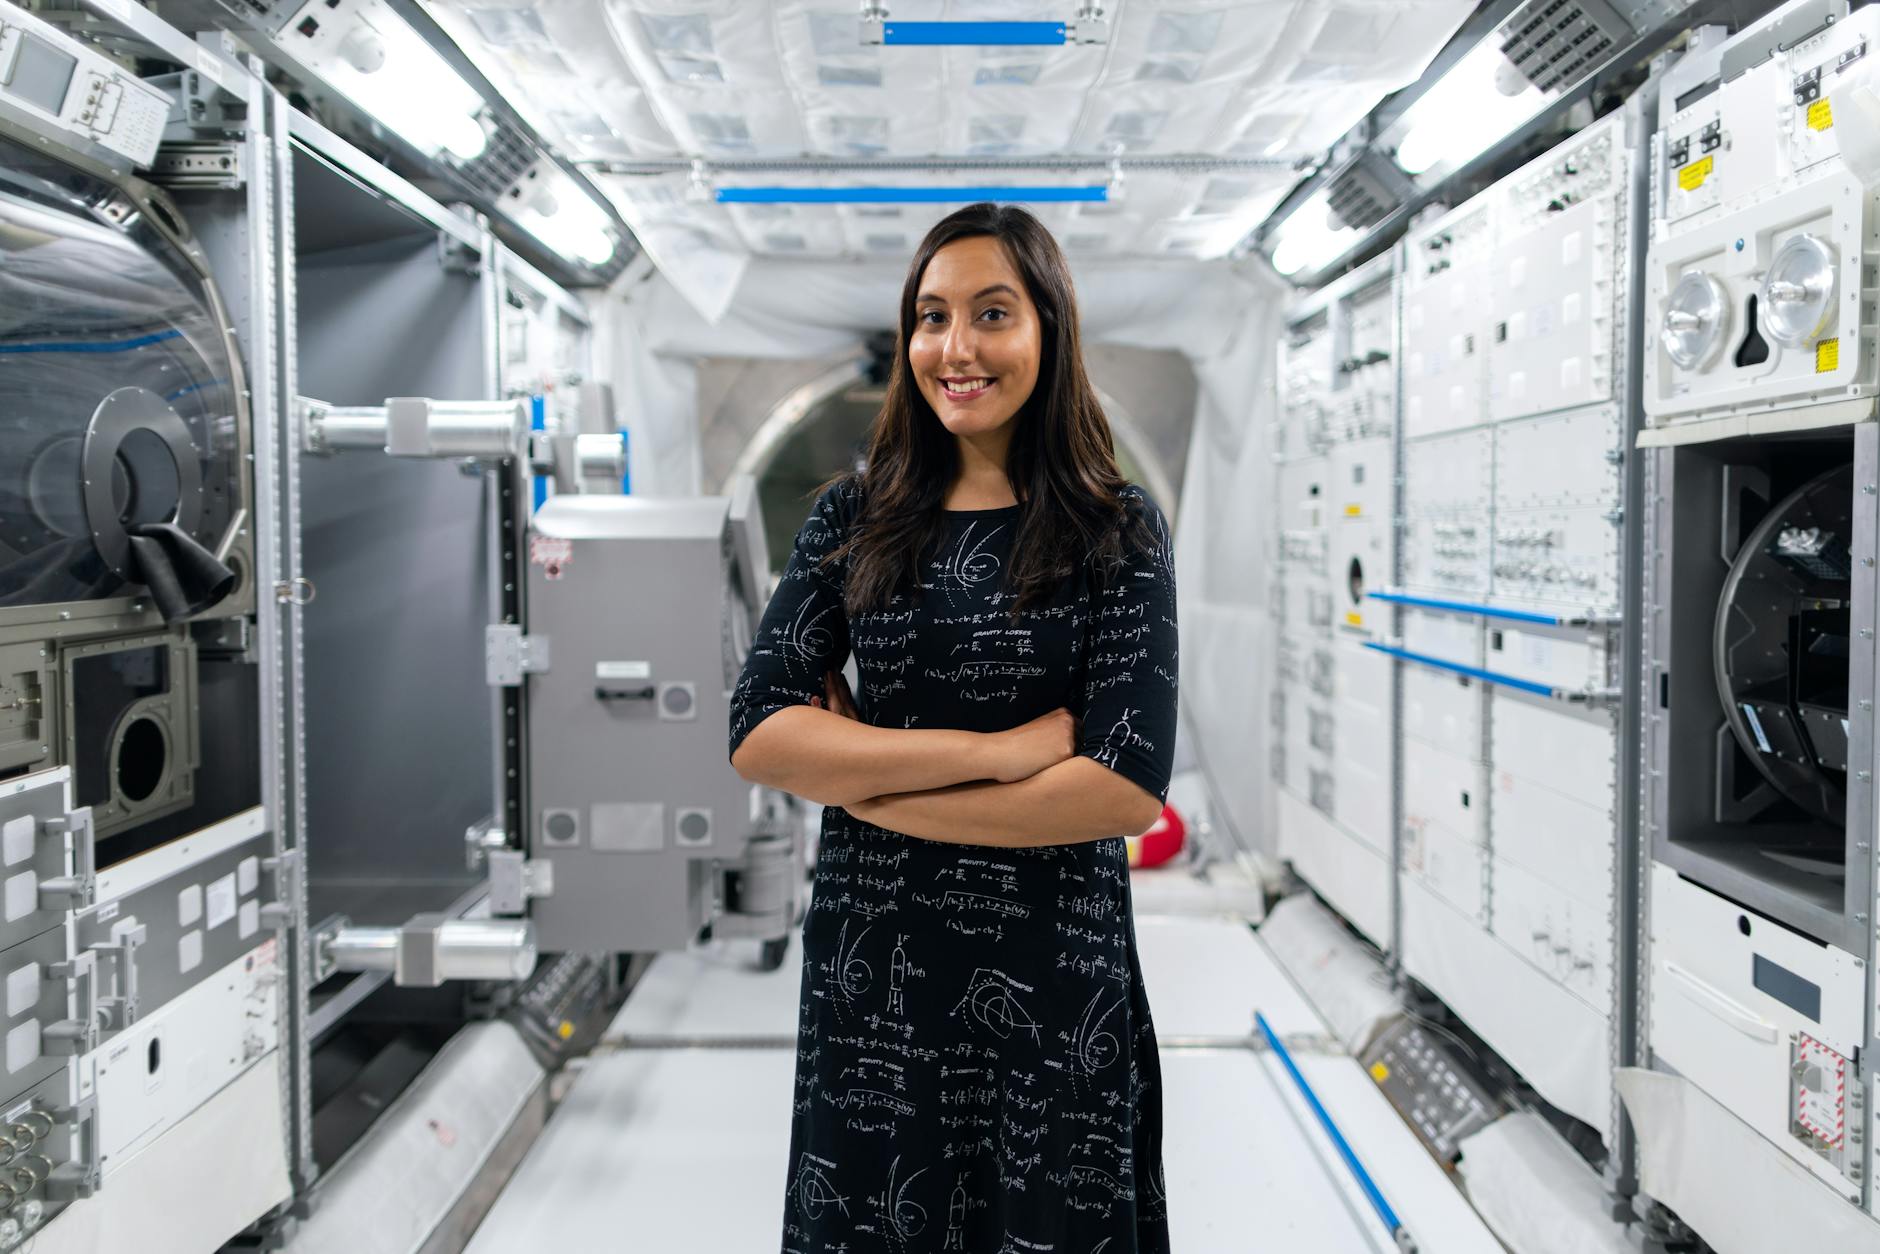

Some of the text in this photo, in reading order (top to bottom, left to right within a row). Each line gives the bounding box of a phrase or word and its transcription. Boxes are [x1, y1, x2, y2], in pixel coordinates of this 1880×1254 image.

[972, 629, 1002, 637] GRAVITY
[1131, 709, 1141, 717] F
[958, 858, 1017, 872] GRAVITY LOSSES
